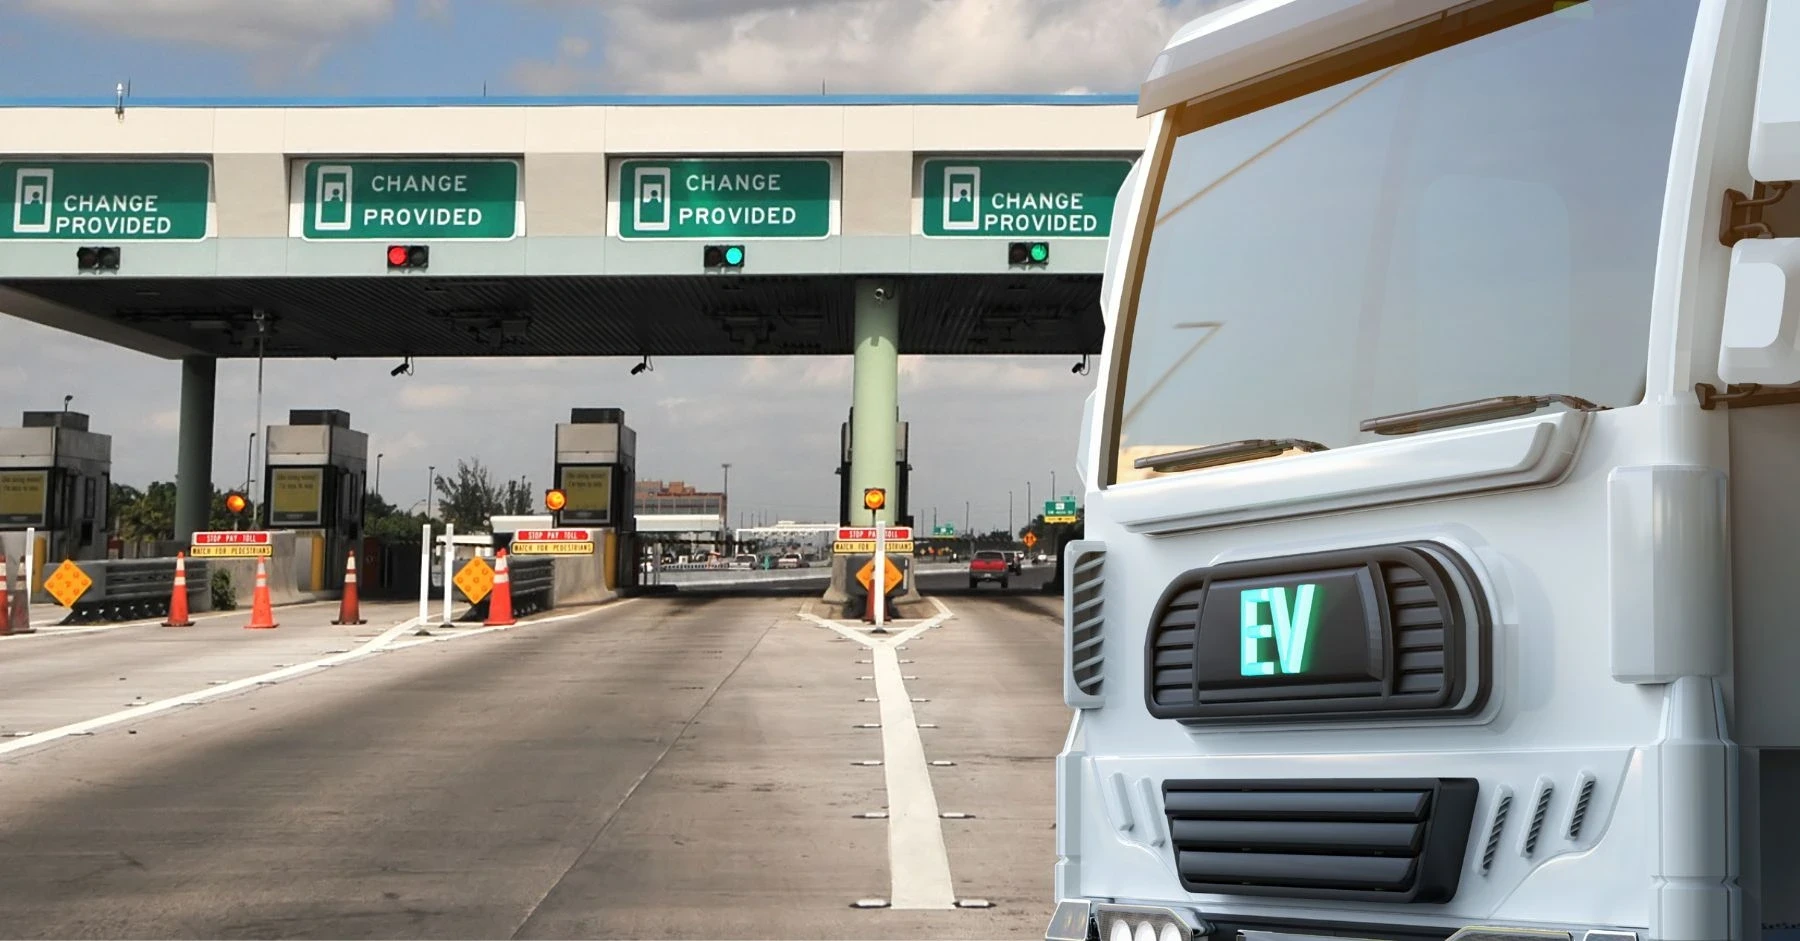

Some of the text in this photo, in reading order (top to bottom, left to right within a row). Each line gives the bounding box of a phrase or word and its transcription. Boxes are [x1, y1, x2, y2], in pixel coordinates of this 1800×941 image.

[371, 174, 468, 193] CHANGE
[685, 173, 782, 192] CHANGE
[63, 194, 158, 212] CHANGE
[991, 191, 1084, 210] CHANGE
[363, 207, 483, 226] PROVIDED
[678, 206, 797, 225] PROVIDED
[983, 213, 1098, 232] PROVIDED
[55, 216, 171, 235] PROVIDED
[207, 534, 256, 543] STOP PAY TOLL
[528, 531, 577, 540] STOP PAY TOLL
[849, 531, 864, 539] STOP
[193, 547, 270, 555] WATCH FOR PEDESTRIANS
[514, 544, 591, 553] WATCH FOR PEDESTRIANS
[1240, 584, 1316, 677] EV
